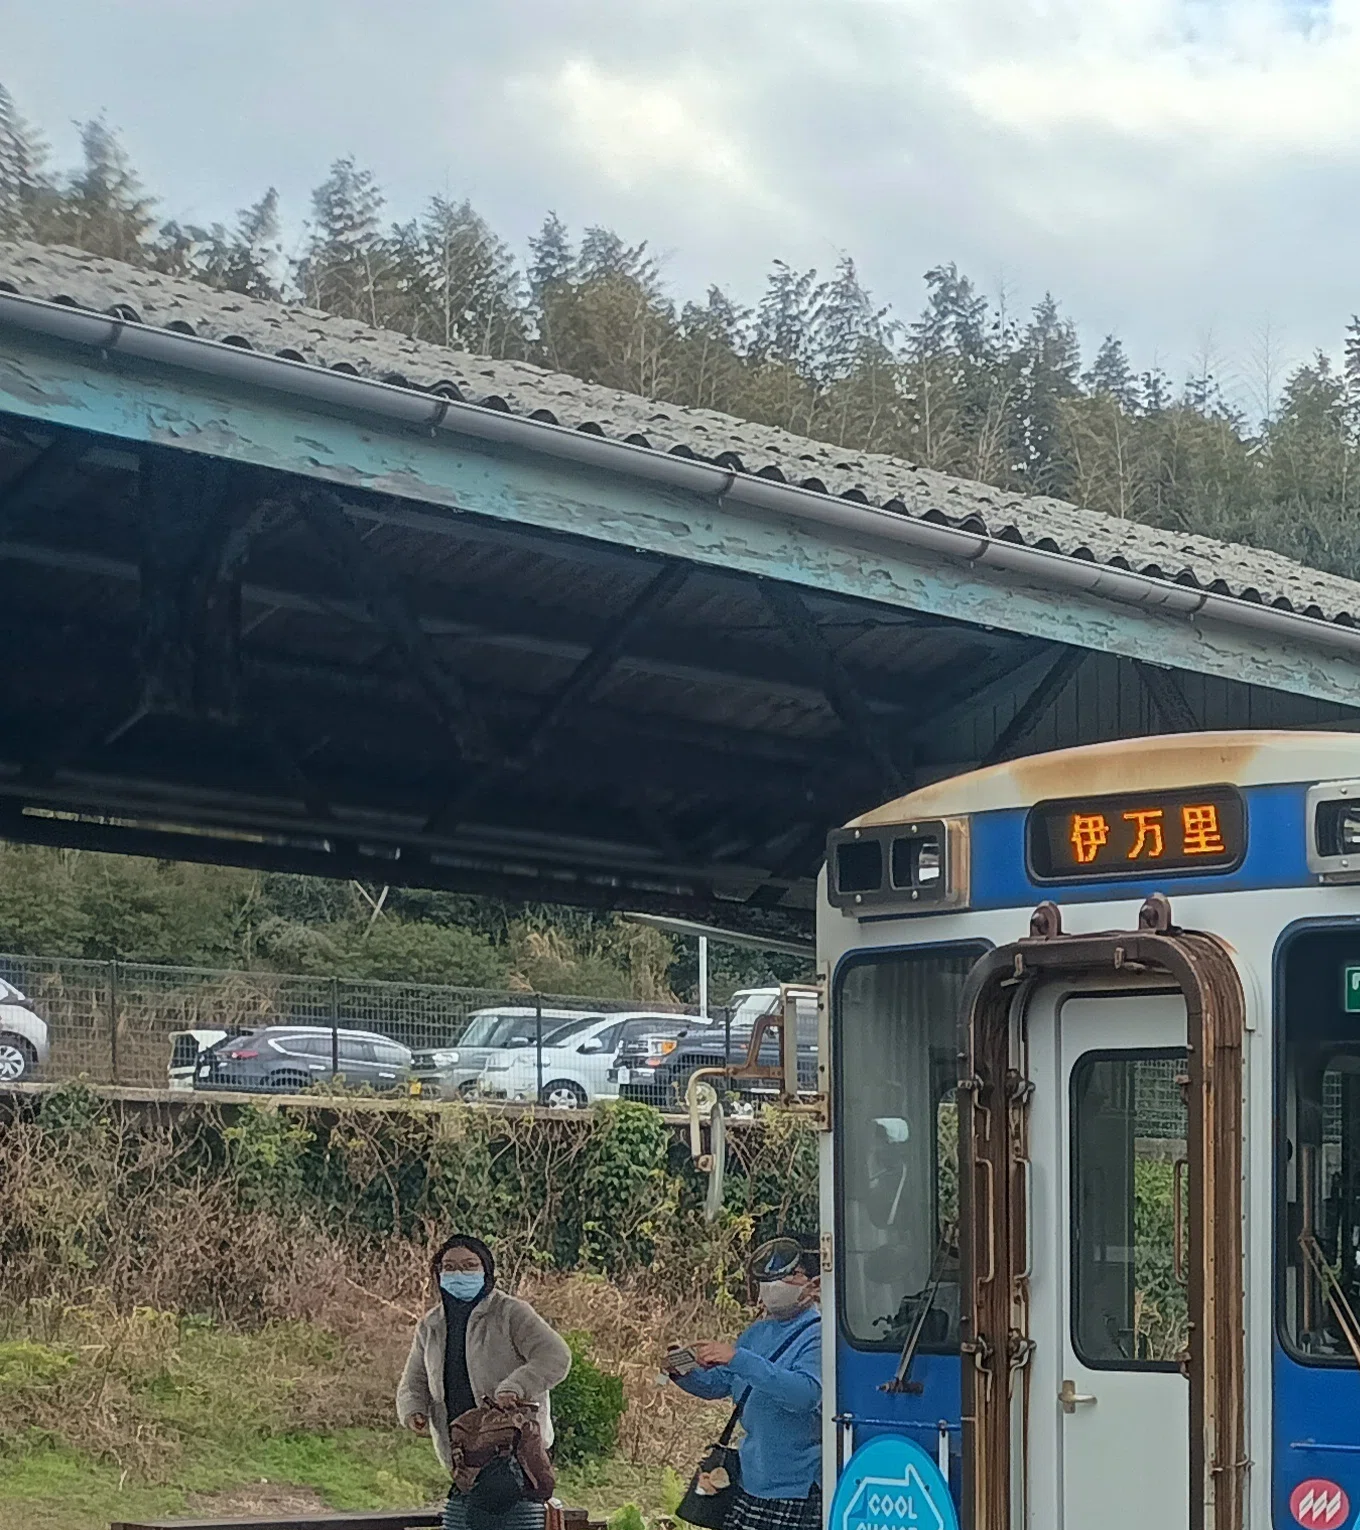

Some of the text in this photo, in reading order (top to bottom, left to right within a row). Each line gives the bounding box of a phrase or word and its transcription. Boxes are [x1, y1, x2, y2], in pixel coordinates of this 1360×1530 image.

[1071, 804, 1225, 863] 伊万里
[868, 1493, 918, 1520] COOL
